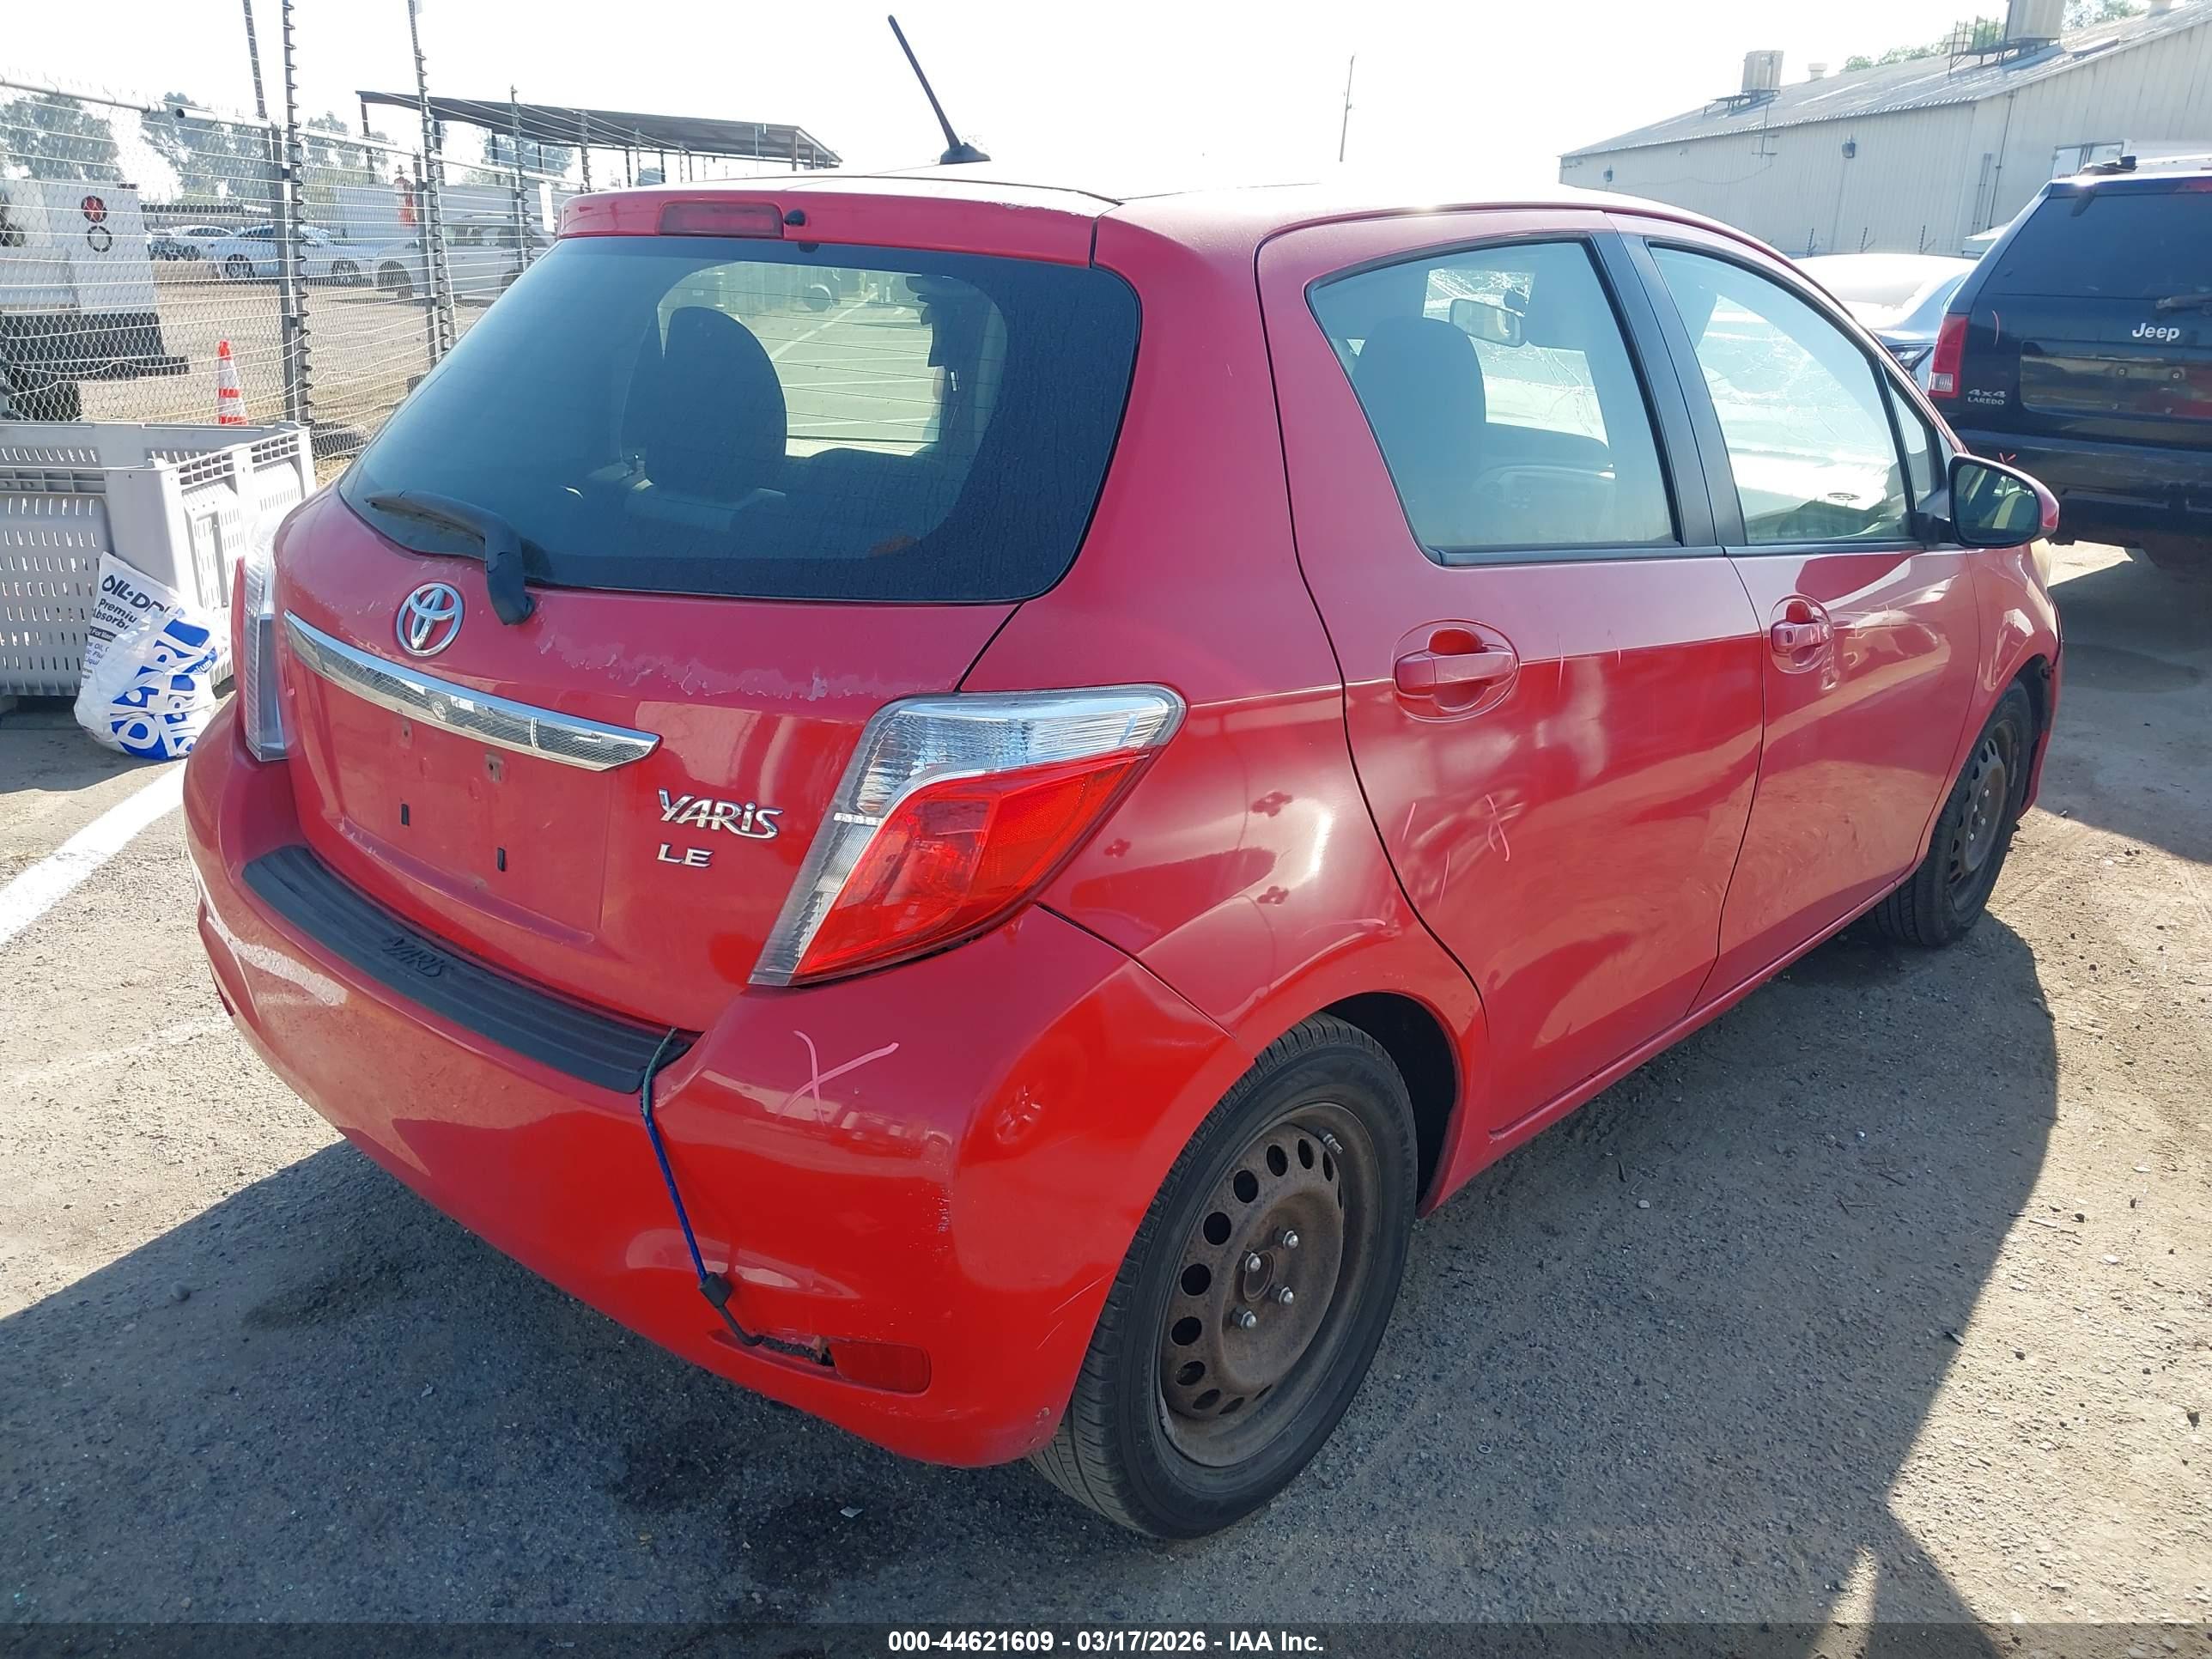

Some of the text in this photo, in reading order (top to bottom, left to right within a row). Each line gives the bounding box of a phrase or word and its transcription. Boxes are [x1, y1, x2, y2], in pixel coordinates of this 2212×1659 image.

[2132, 323, 2180, 342] Jeep
[1969, 389, 2007, 398] 4x4
[1967, 397, 2005, 406] LAREDO
[657, 843, 714, 867] LE
